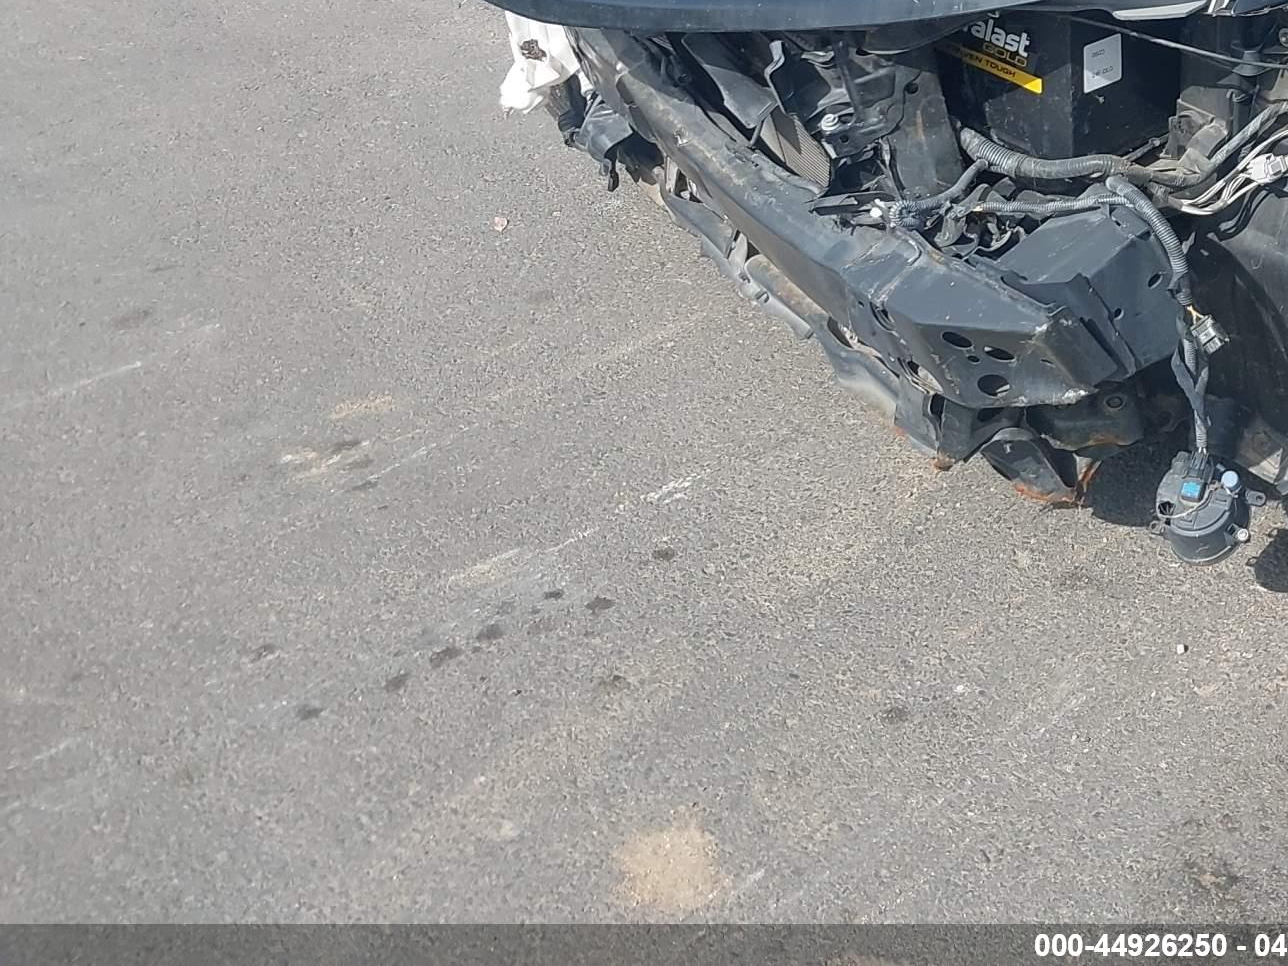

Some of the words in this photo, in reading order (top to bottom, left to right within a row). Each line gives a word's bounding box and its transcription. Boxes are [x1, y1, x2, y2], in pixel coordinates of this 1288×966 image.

[963, 19, 1031, 57] alast
[983, 42, 1028, 67] GOLD
[985, 60, 1016, 77] TOUGH
